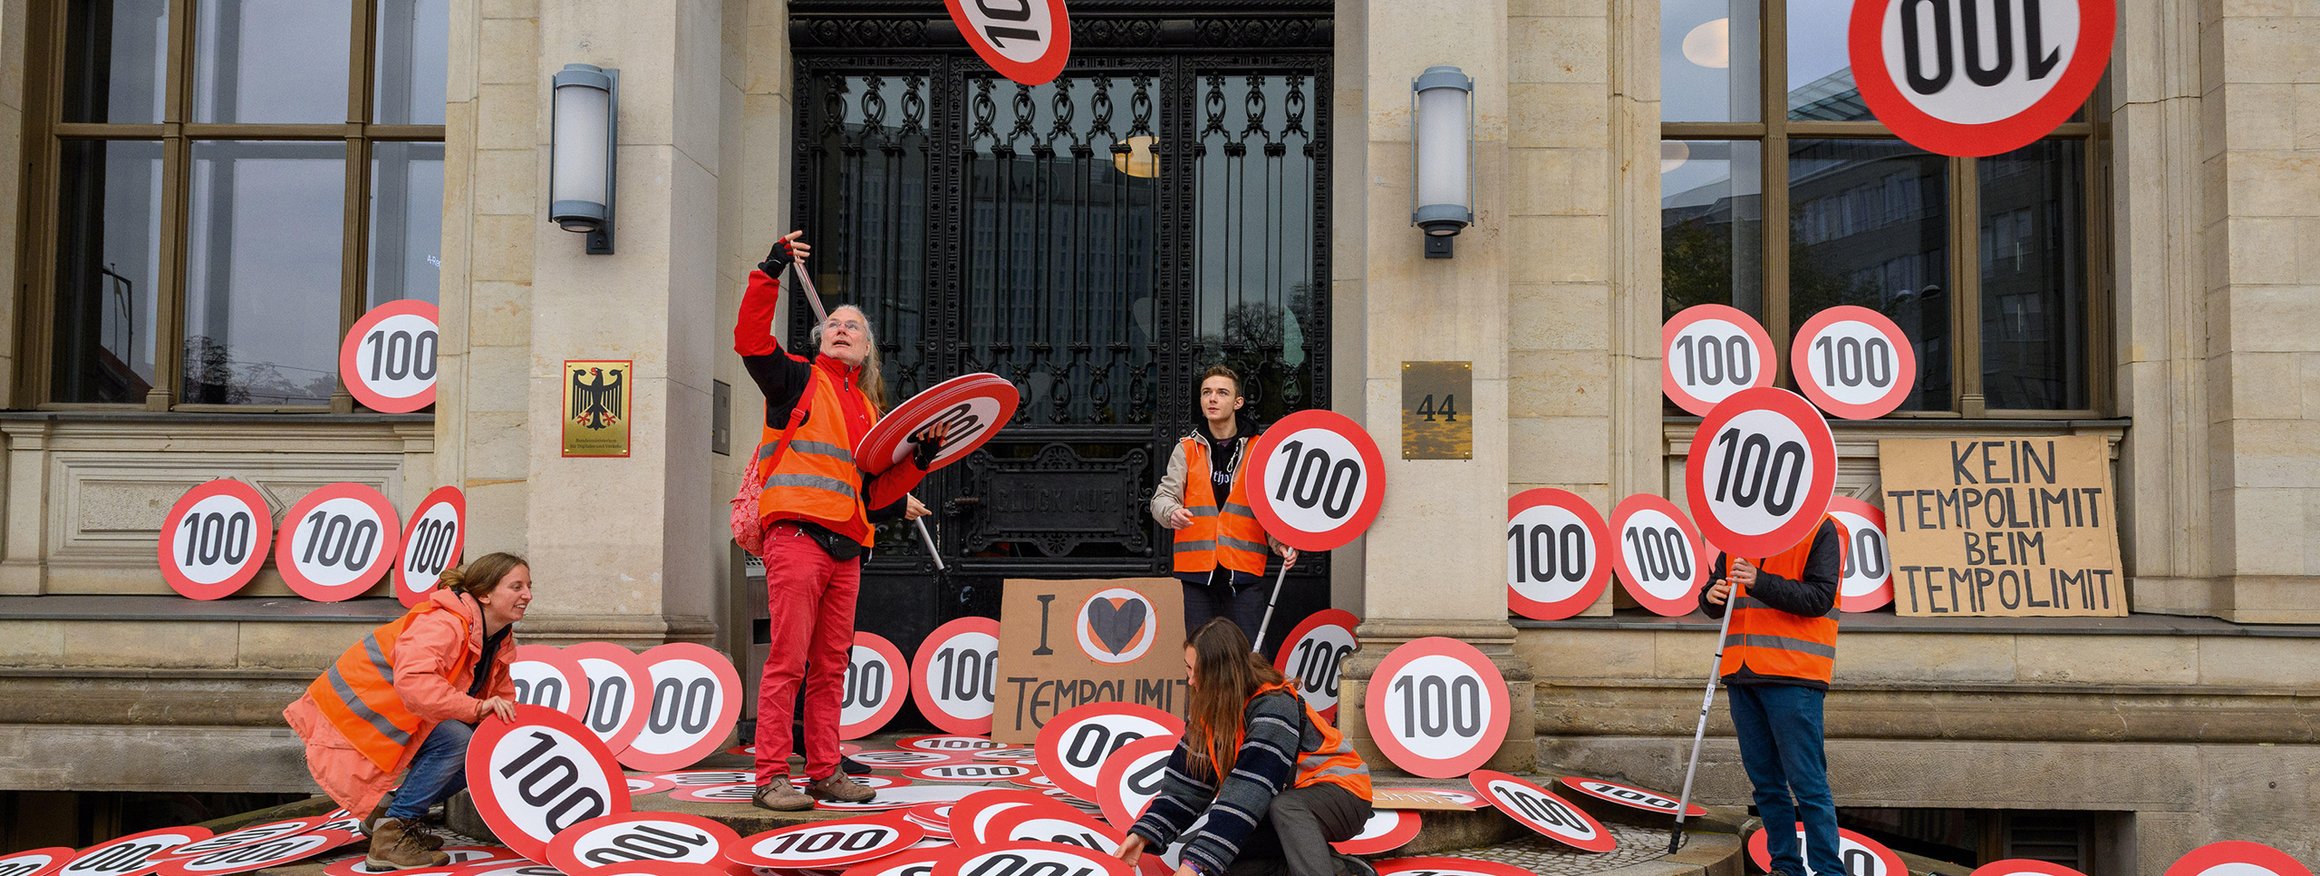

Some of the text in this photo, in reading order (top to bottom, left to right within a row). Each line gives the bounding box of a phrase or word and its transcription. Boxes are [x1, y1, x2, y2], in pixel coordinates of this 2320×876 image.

[976, 0, 1041, 48] 10
[1900, 0, 2061, 95] 100
[367, 330, 438, 381] 100
[1676, 335, 1752, 386] 100
[1815, 336, 1891, 388] 100
[1416, 393, 1457, 422] 44
[1276, 440, 1361, 520] 100
[1715, 427, 1806, 517] 100
[1950, 440, 2056, 485] KEIN
[1887, 487, 2101, 532] TEMPOLIMIT
[183, 511, 250, 567] 100
[302, 510, 378, 572] 100
[408, 518, 455, 576] 100
[1507, 523, 1587, 583] 100
[1626, 526, 1691, 582] 100
[1964, 531, 2046, 566] BEIM
[1899, 566, 2113, 613] TEMPOLIMIT
[1032, 594, 1056, 656] I
[650, 677, 715, 734] 00
[1395, 675, 1481, 738] 100
[499, 731, 605, 836] 100
[932, 766, 1020, 776] 100
[1594, 783, 1679, 810] 100
[1494, 785, 1589, 833] 100
[769, 829, 889, 854] 100
